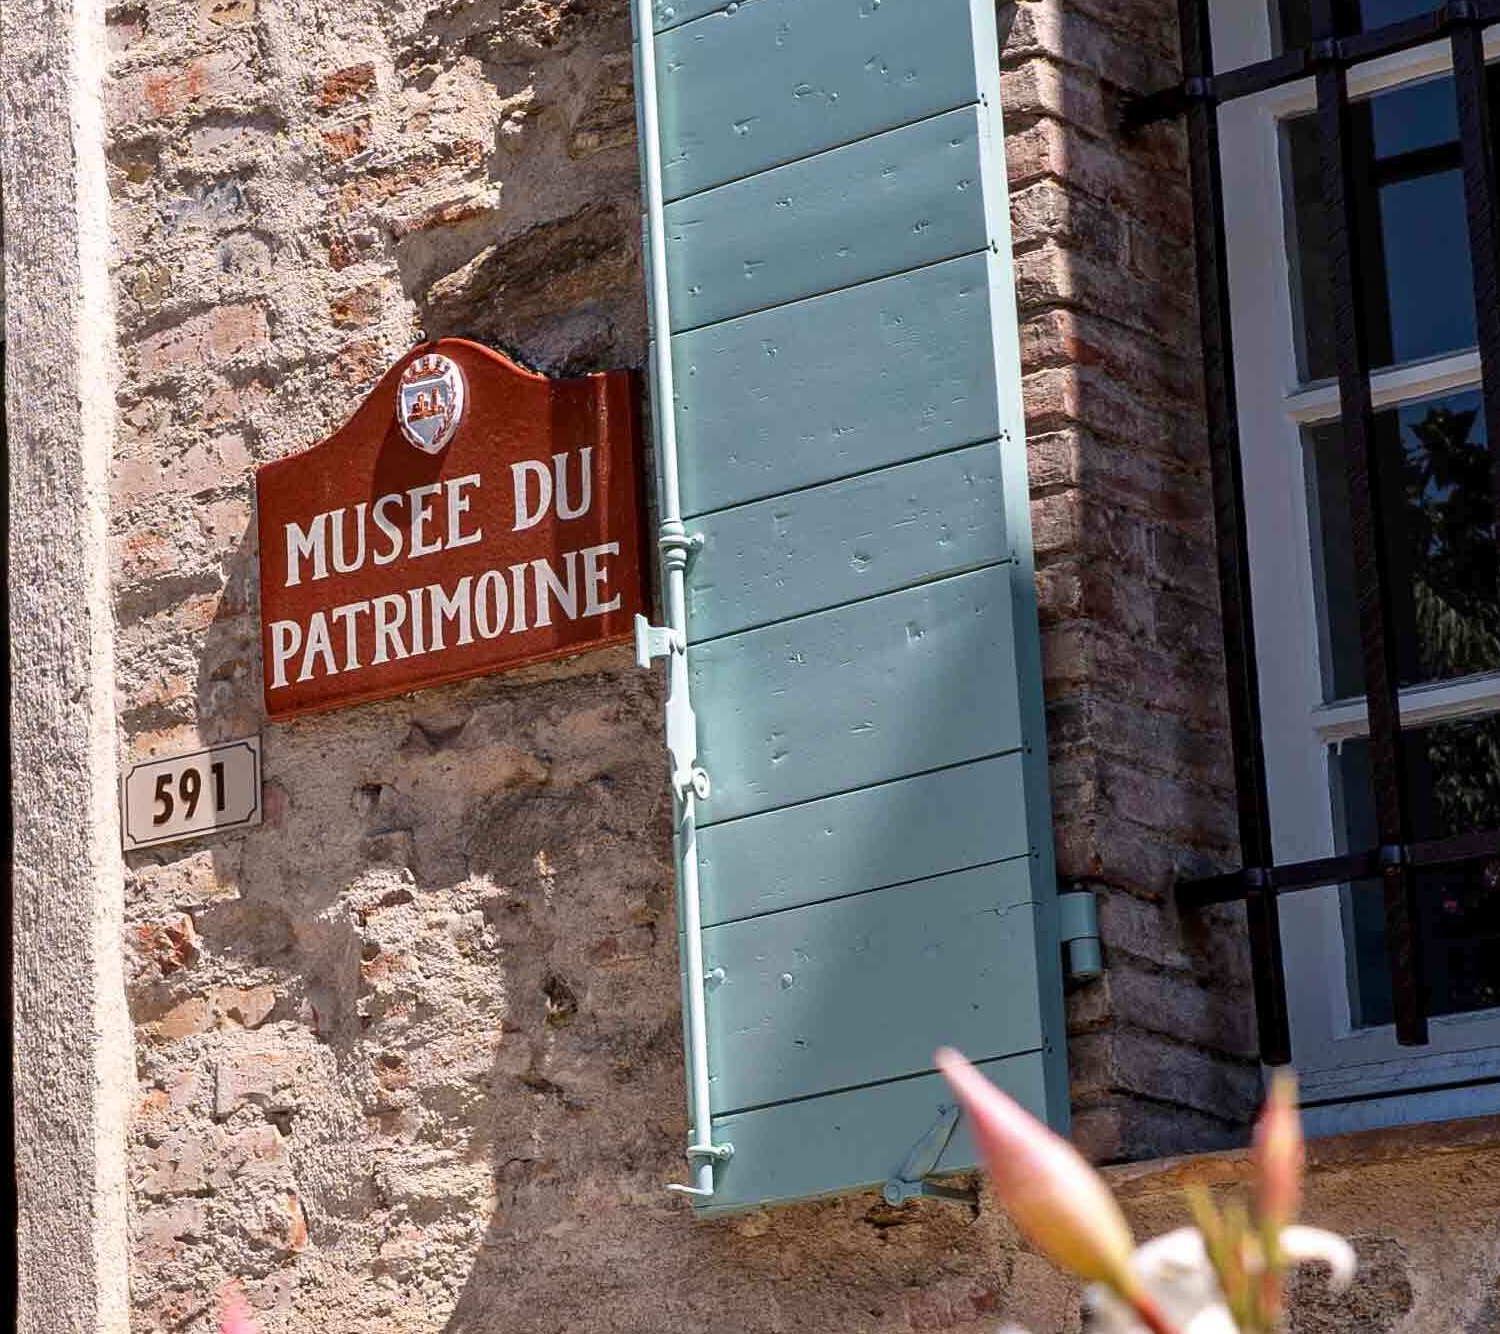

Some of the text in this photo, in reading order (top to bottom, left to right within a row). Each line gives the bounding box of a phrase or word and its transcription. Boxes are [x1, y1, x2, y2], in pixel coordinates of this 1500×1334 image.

[283, 446, 594, 589] MUSEE DU
[268, 541, 623, 692] PATRIMOINE
[152, 761, 229, 828] 591
